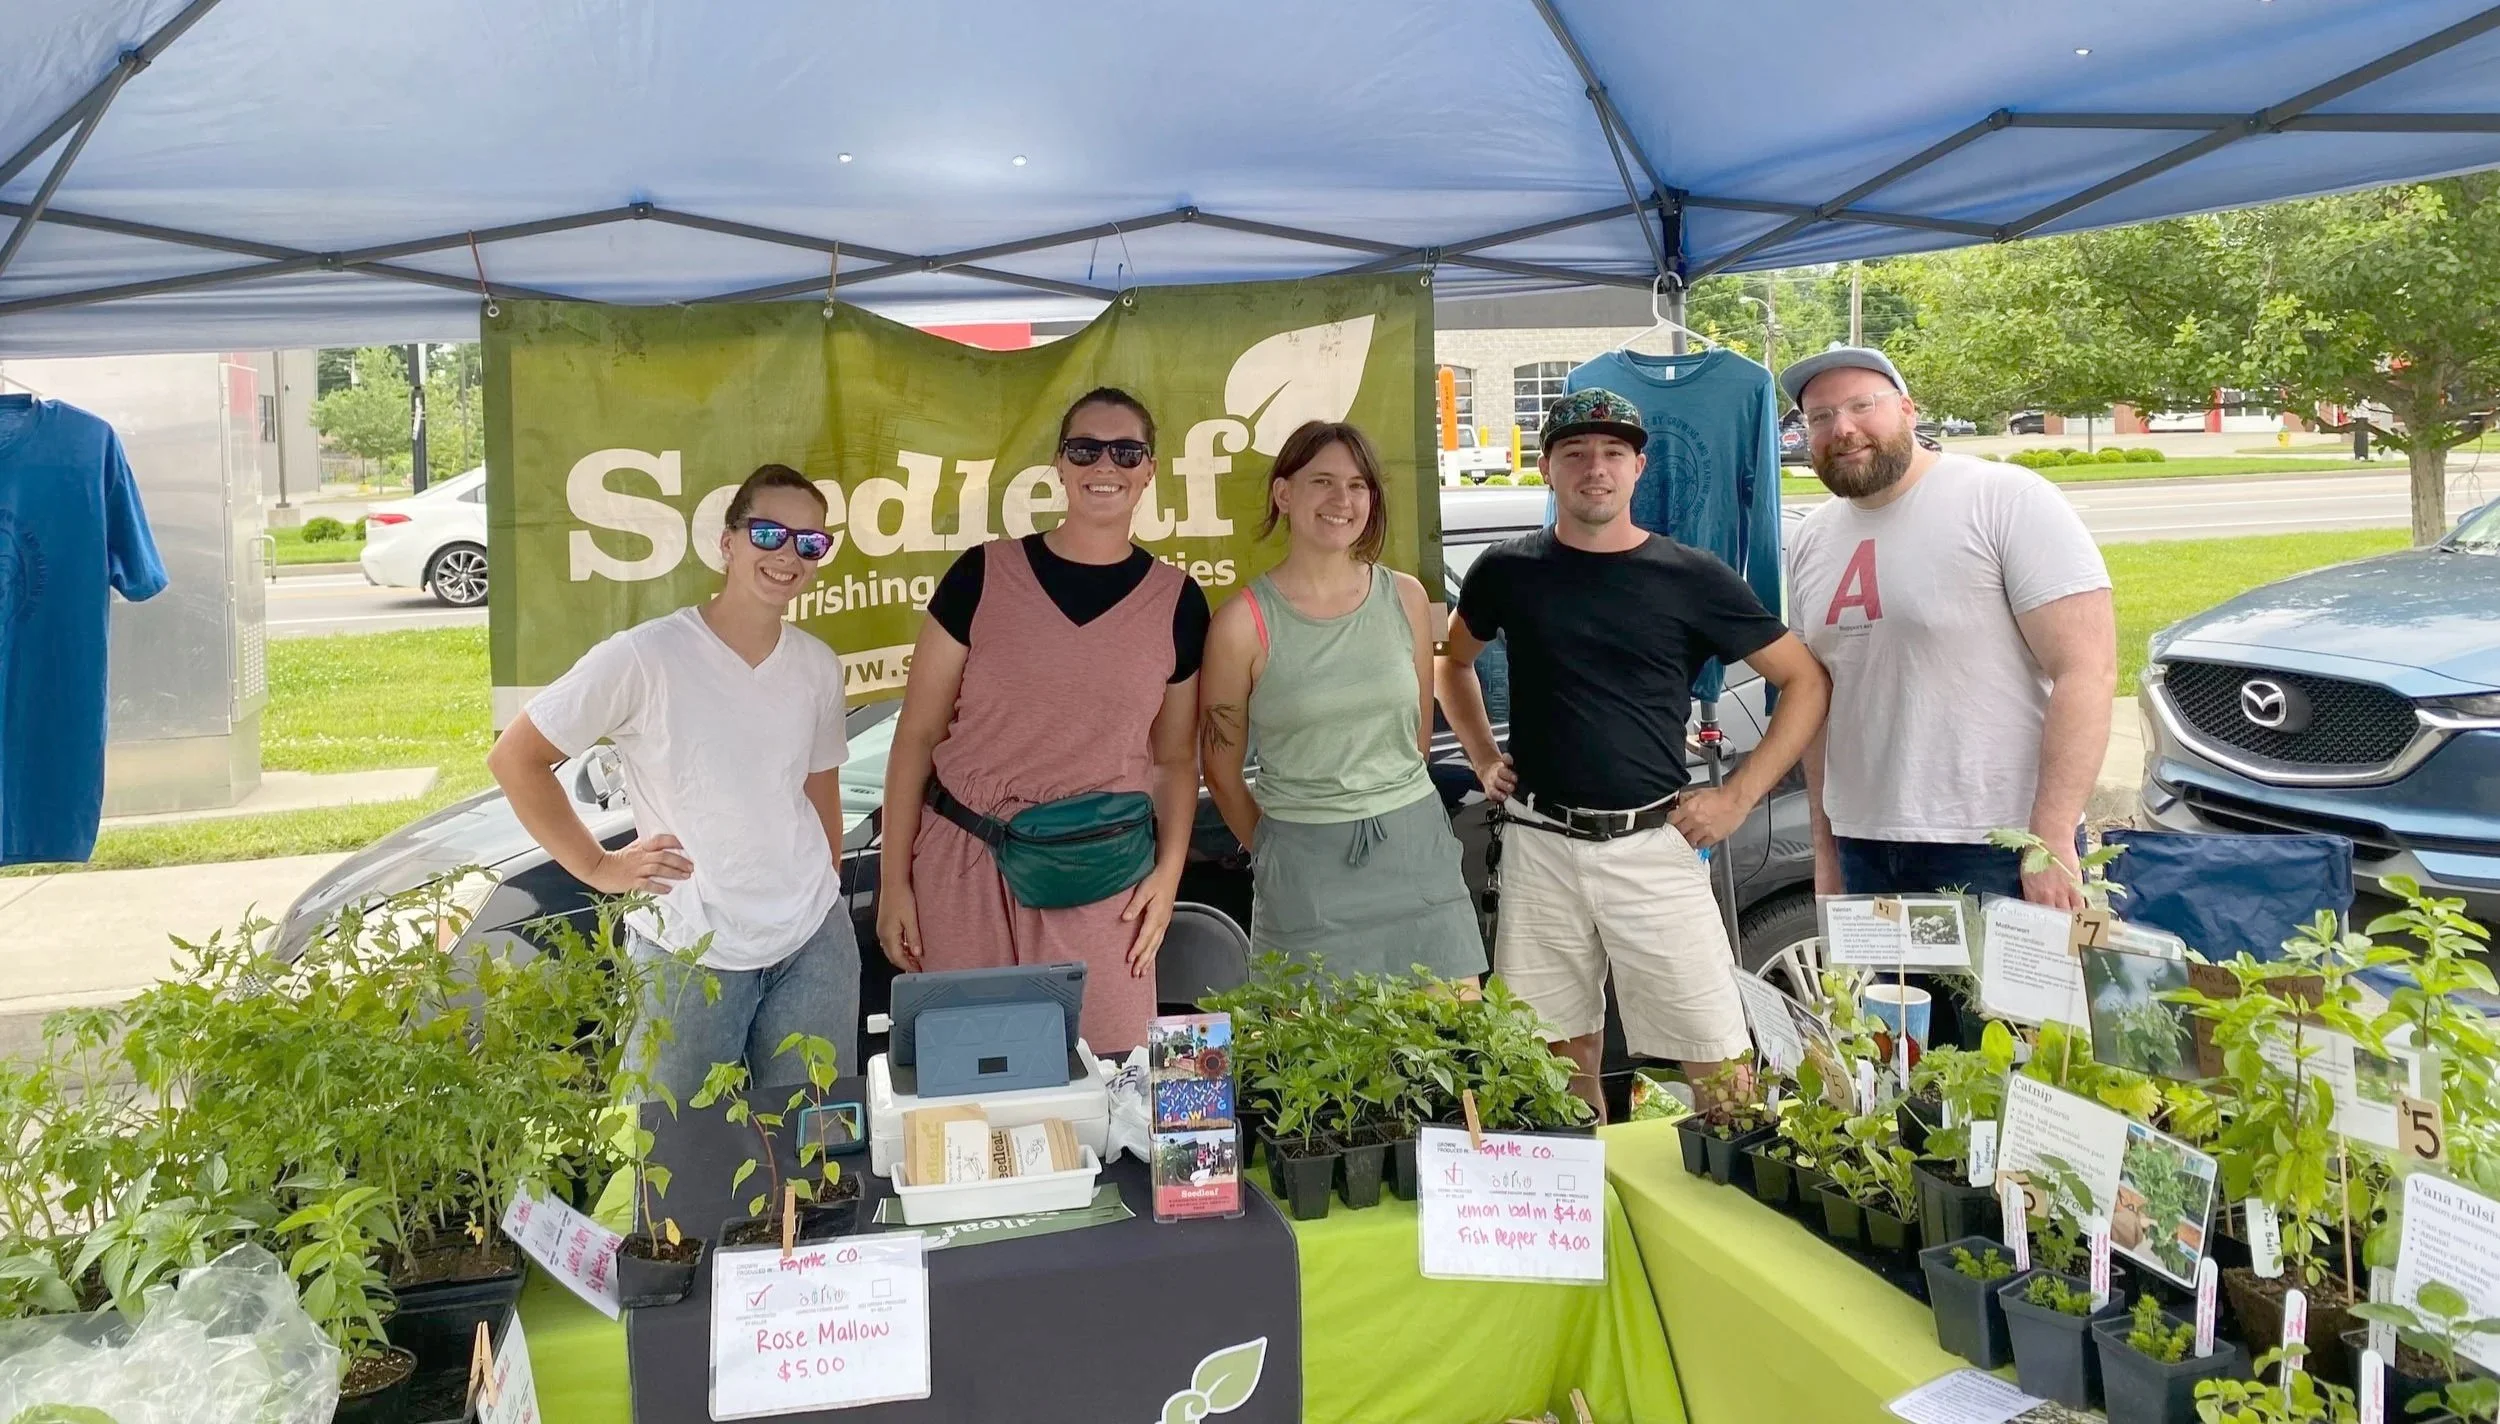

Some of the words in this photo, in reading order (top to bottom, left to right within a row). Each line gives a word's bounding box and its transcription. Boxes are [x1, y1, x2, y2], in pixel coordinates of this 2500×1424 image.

[566, 418, 1250, 582] Sdlef
[1825, 538, 1883, 625] A
[1995, 921, 2030, 934] Motherwort
[2075, 912, 2100, 946] $7
[2014, 1078, 2052, 1102] Catnip
[2402, 1100, 2441, 1160] $5
[1480, 1139, 1522, 1161] Fayette
[1181, 1187, 1220, 1198] Seedleaf
[2414, 1180, 2451, 1206] Vana
[2456, 1196, 2495, 1223] Tulsi
[1509, 1202, 1547, 1220] balm
[1553, 1204, 1592, 1224] $4.00
[1458, 1226, 1489, 1245] Fish
[1549, 1228, 1590, 1250] $4.00
[2265, 1231, 2276, 1255] Basil
[779, 1252, 826, 1274] Fayette
[757, 1329, 807, 1353] Rose
[819, 1320, 889, 1344] Mallow
[778, 1357, 845, 1382] $5.00
